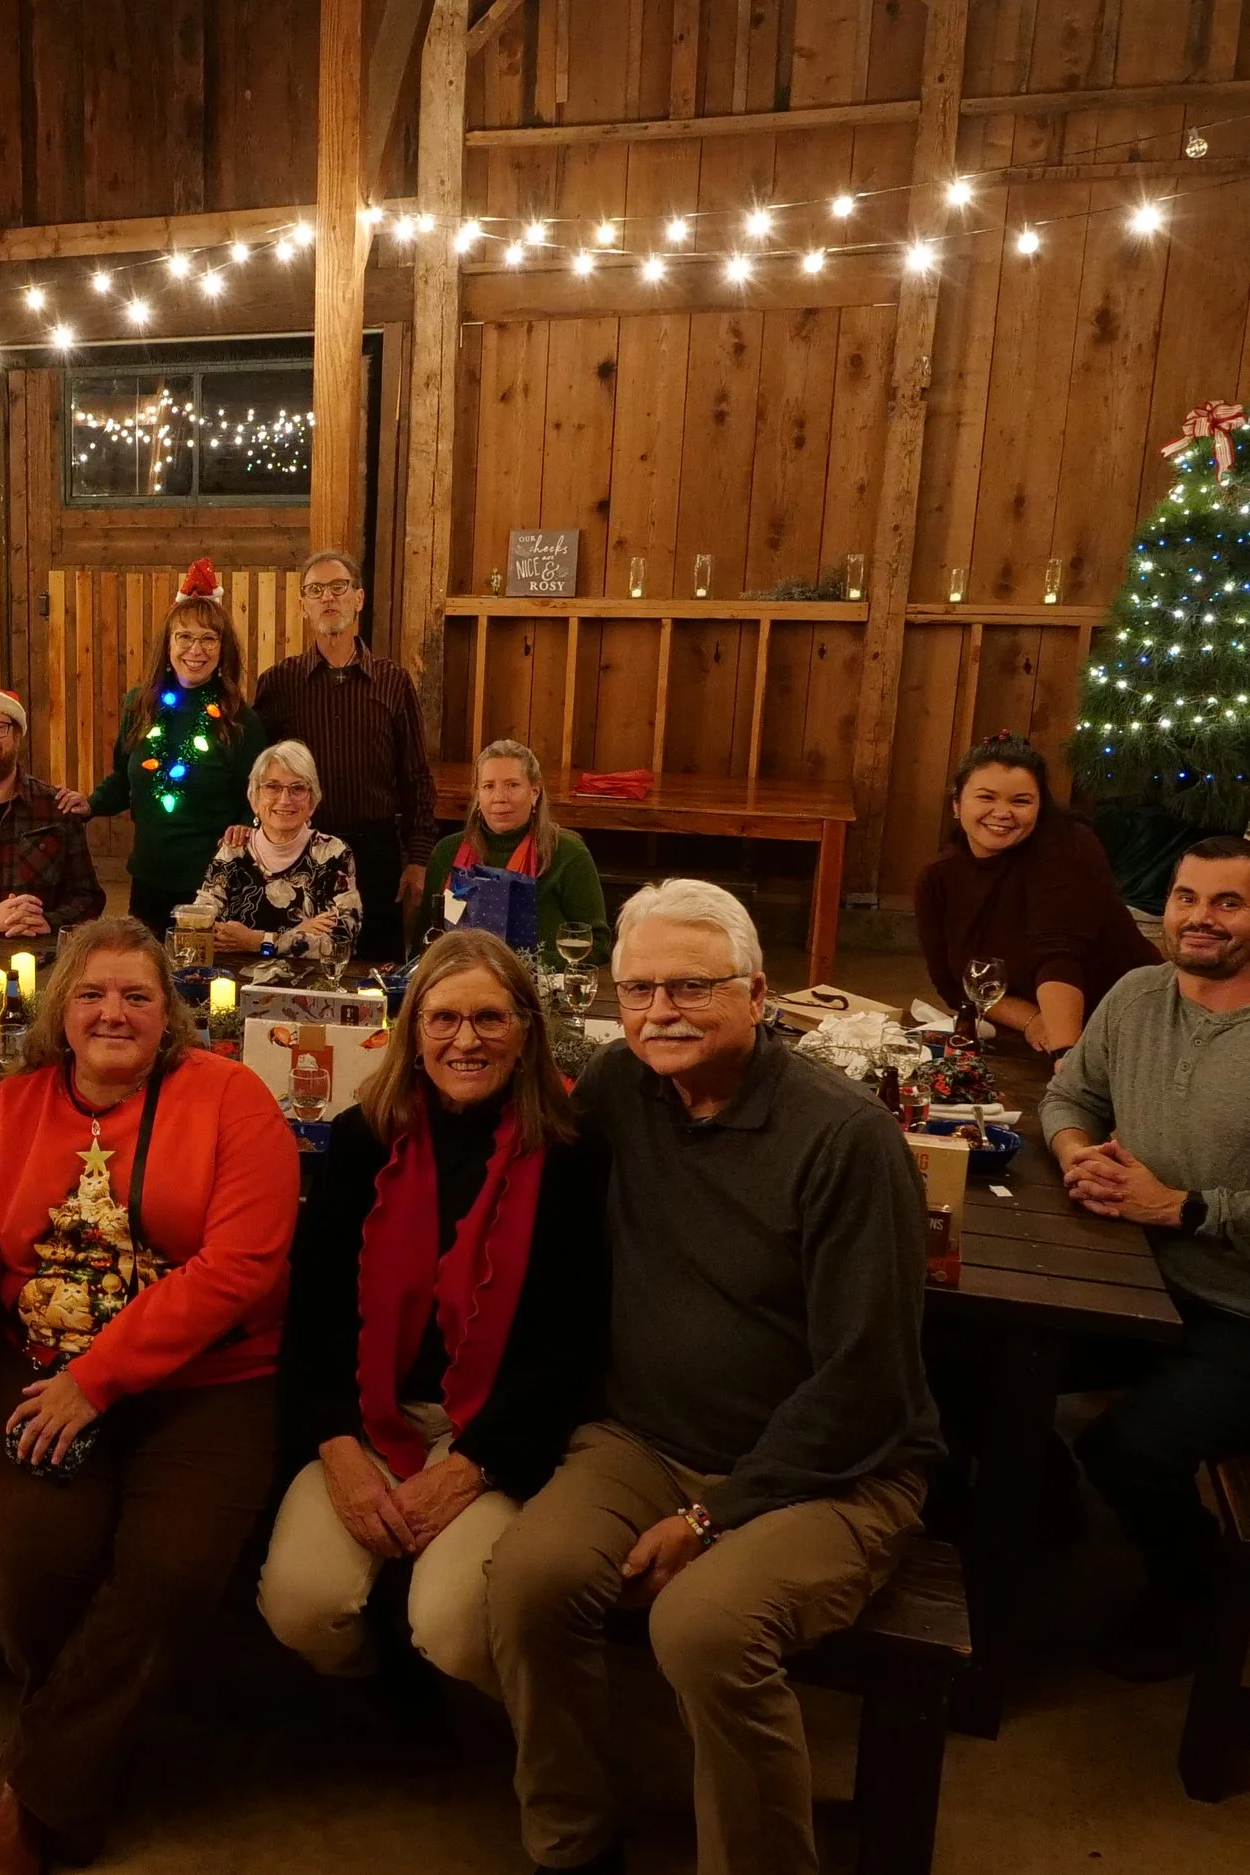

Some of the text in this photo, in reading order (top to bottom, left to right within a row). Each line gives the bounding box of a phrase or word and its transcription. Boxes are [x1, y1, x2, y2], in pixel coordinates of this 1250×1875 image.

[518, 535, 536, 543] OUR
[515, 556, 560, 581] NICE &
[529, 581, 565, 591] ROSY
